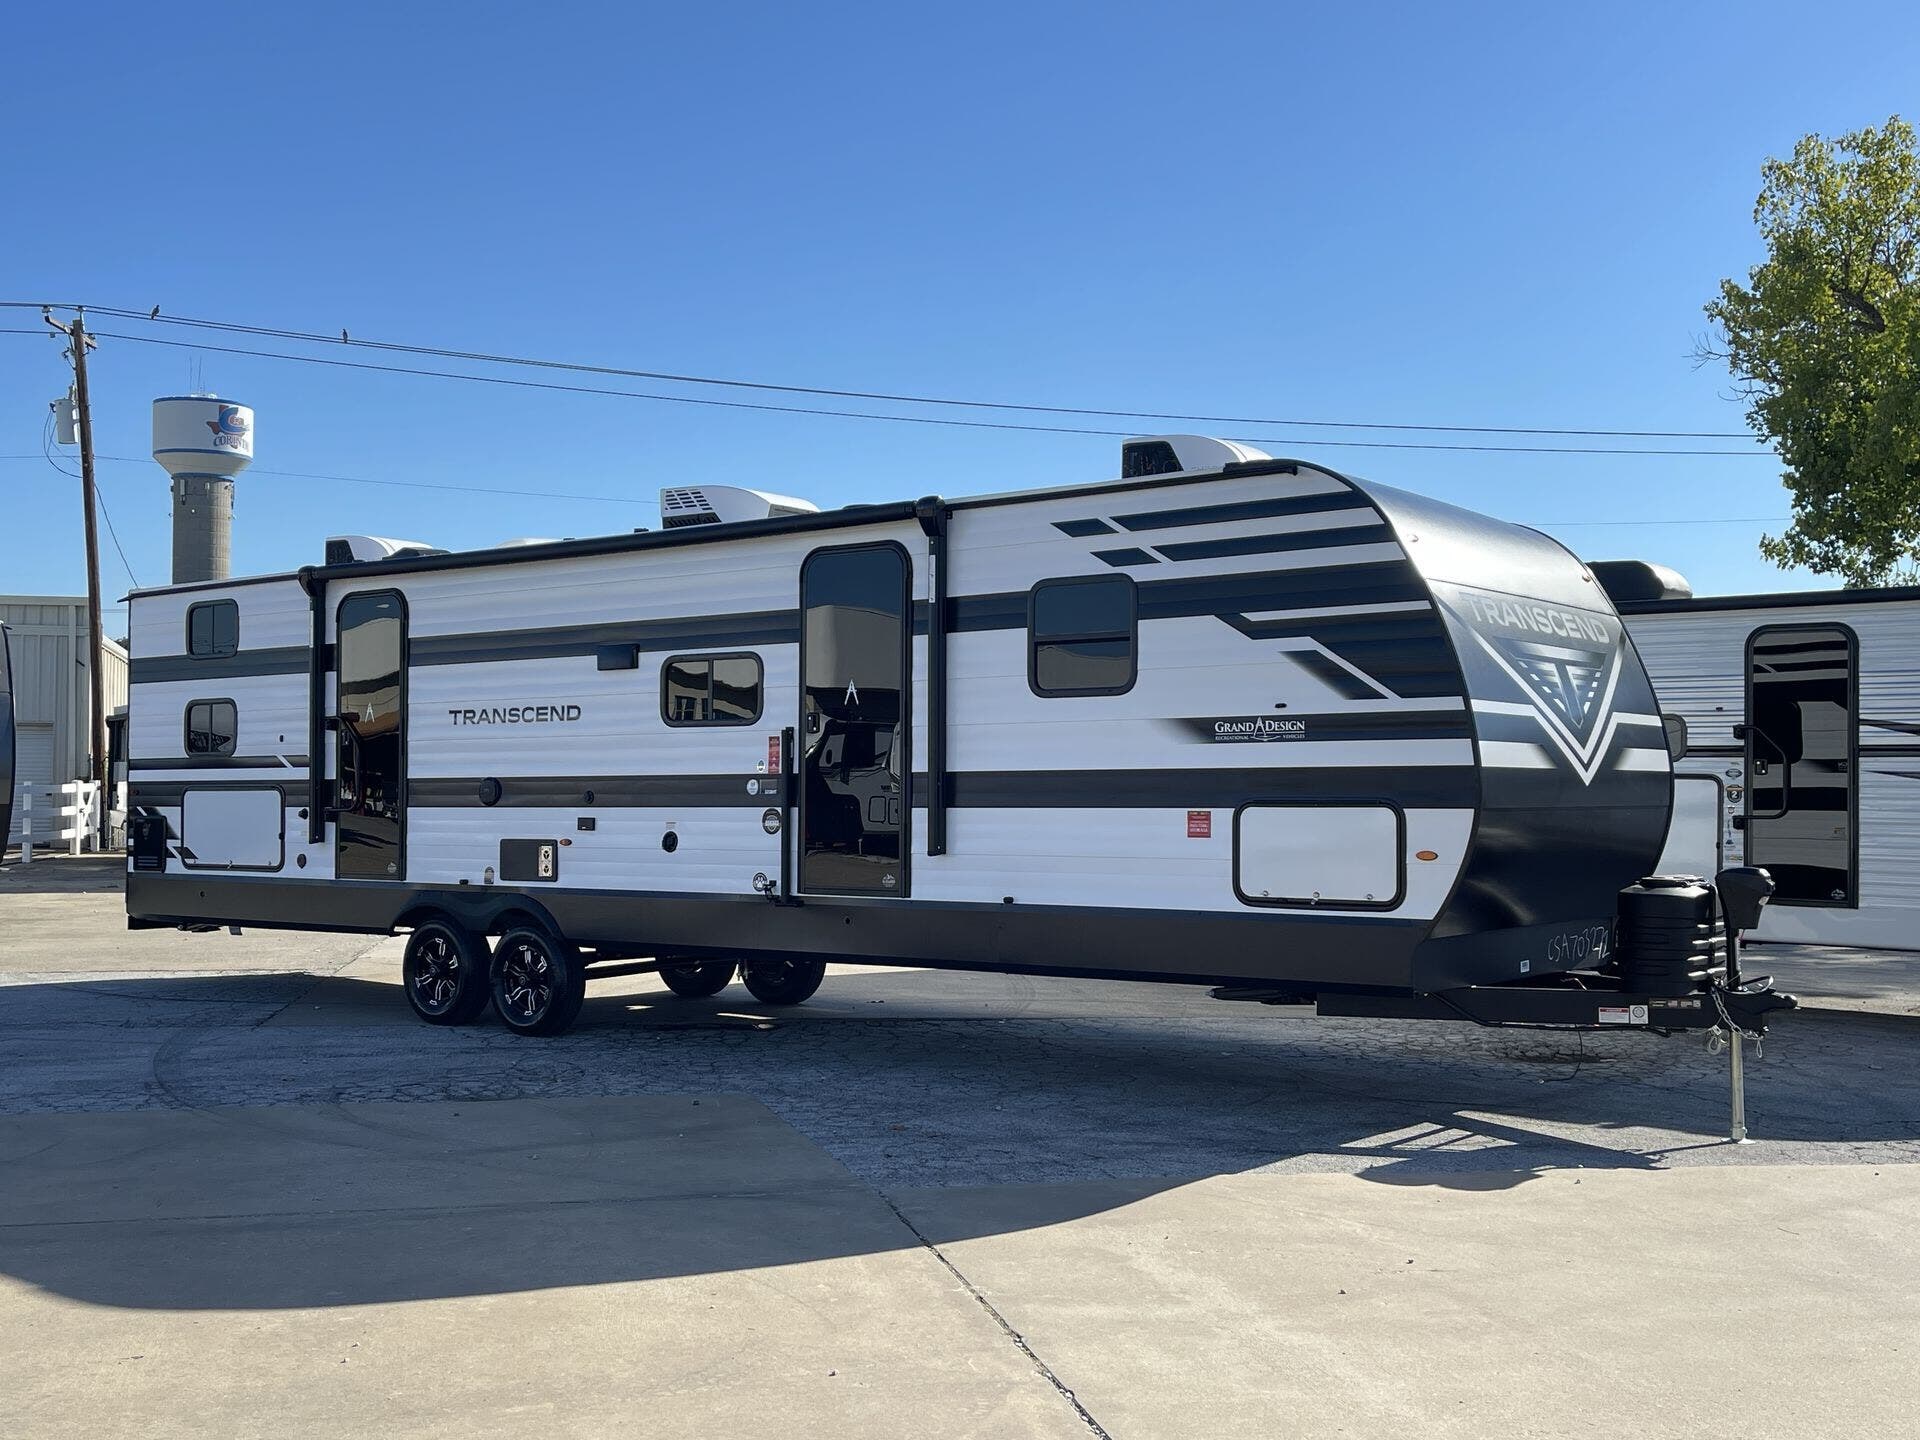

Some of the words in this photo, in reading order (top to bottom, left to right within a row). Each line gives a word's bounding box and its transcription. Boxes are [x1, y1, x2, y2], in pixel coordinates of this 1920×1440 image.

[1458, 592, 1610, 643] TRANSCEND
[448, 704, 581, 725] TRANSCEND
[1214, 721, 1254, 732] GRAND
[1265, 720, 1305, 731] DESIGN
